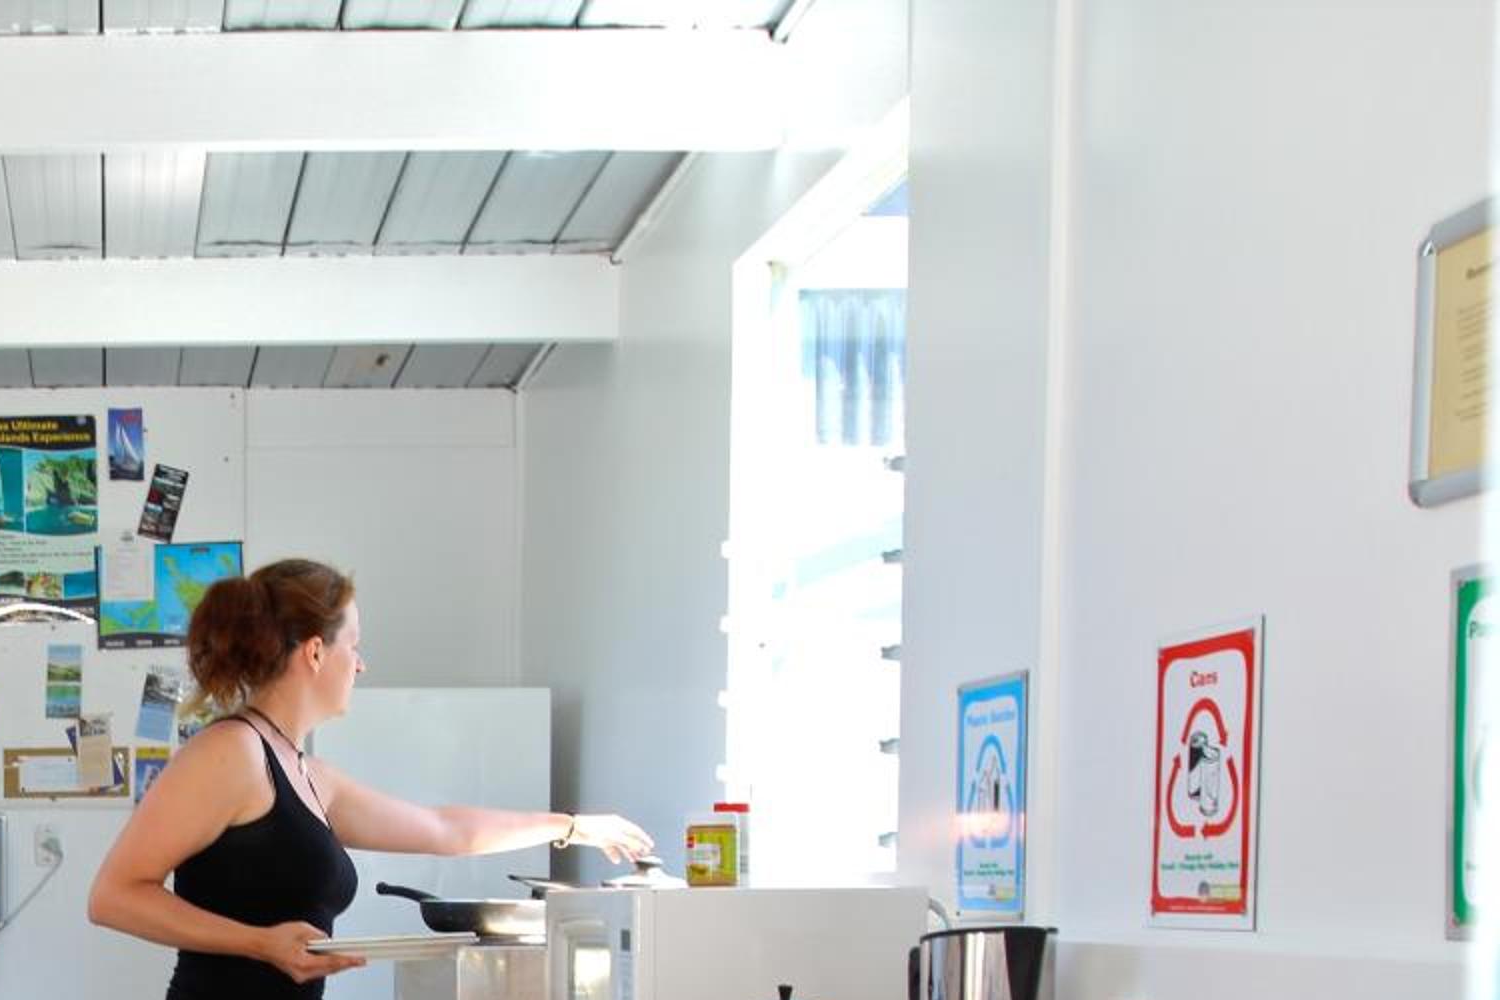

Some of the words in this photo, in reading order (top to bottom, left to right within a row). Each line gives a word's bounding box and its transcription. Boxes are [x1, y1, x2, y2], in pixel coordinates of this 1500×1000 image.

[11, 419, 59, 431] Ultimate
[32, 431, 91, 444] Experience
[1189, 669, 1218, 689] Cans
